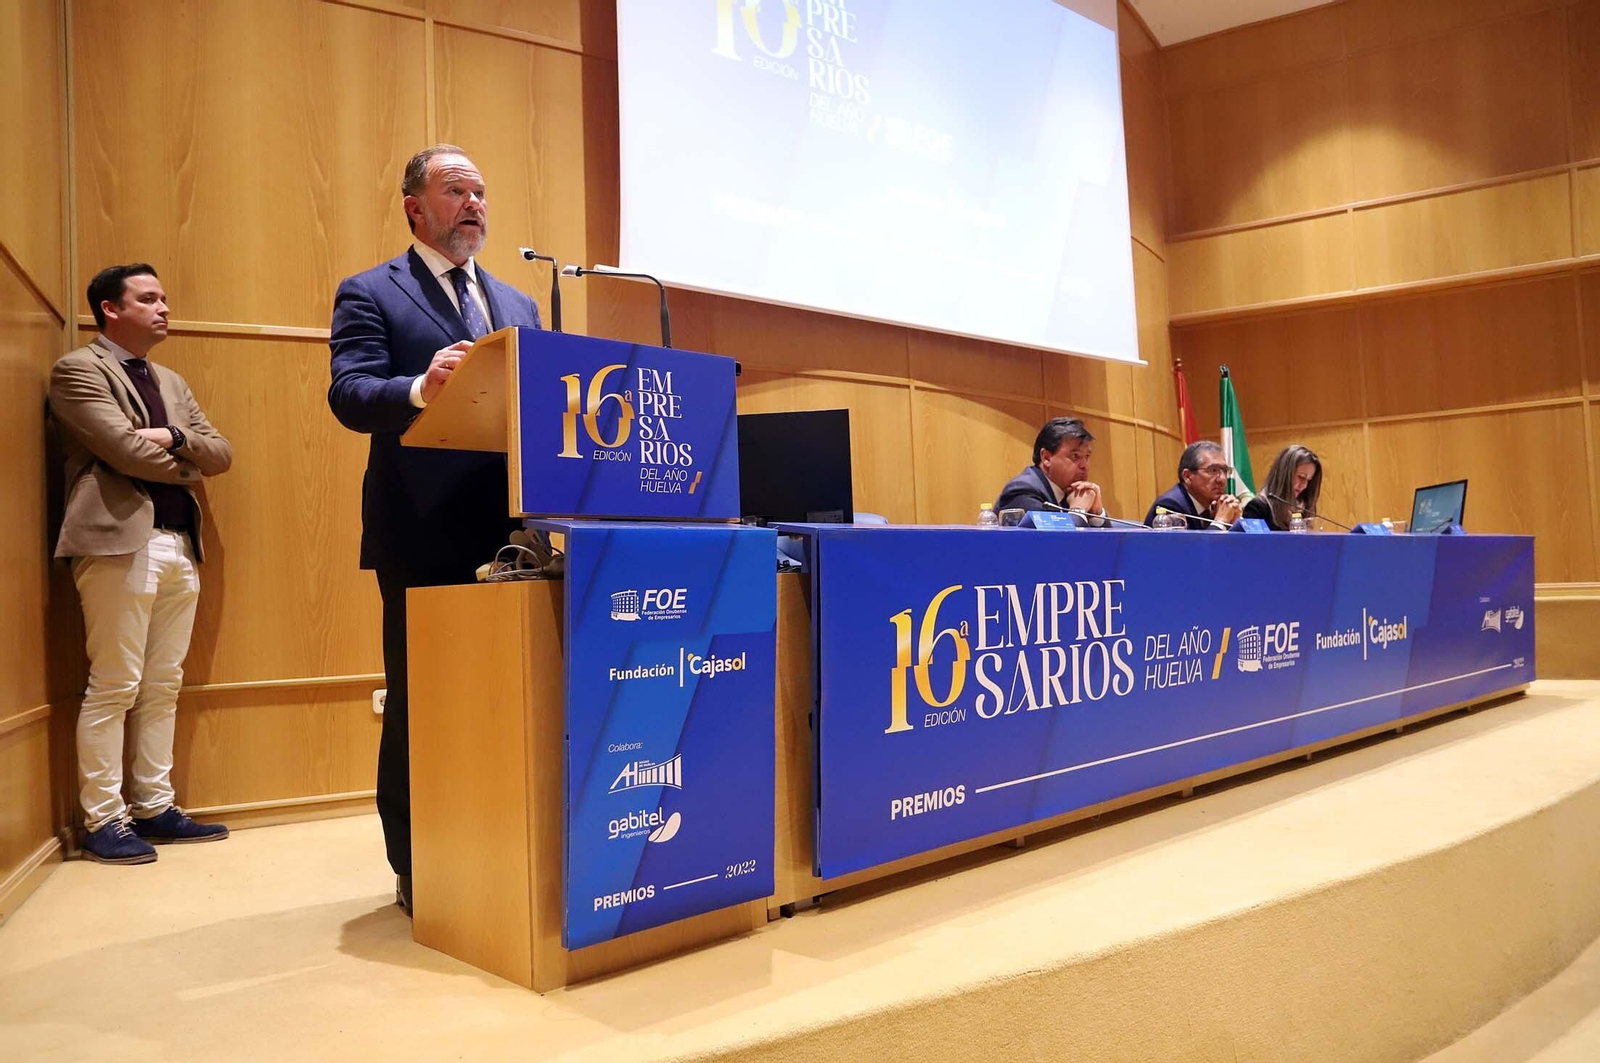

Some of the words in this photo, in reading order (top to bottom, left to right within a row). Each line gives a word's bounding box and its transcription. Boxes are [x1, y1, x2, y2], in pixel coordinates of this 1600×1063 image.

[806, 26, 844, 68] SA
[808, 56, 870, 106] RIOS
[637, 367, 673, 395] EM
[638, 391, 682, 419] PRE
[639, 415, 671, 441] SA
[592, 449, 632, 462] EDICIÓN
[639, 440, 693, 467] RIOS
[640, 468, 661, 481] DEL
[662, 467, 688, 482] AÑO
[640, 481, 682, 494] HUELVA
[642, 588, 687, 610] FOE
[974, 579, 1127, 651] EMPRE
[1144, 634, 1174, 661] DEL
[1177, 626, 1212, 655] AÑO
[1264, 621, 1300, 655] FOE
[1316, 629, 1360, 650] Fundación
[1368, 616, 1407, 649] Cajasol
[609, 663, 675, 681] Fundación
[688, 652, 746, 678] Cajasol
[974, 638, 1135, 719] SARIOS
[1144, 658, 1203, 691] HUELVA
[924, 708, 966, 728] EDICIÓN
[608, 742, 643, 753] Colabora:
[891, 784, 966, 820] PREMIOS
[608, 807, 665, 840] gabitel
[594, 885, 655, 912] PREMIOS
[725, 859, 756, 879] 2022
